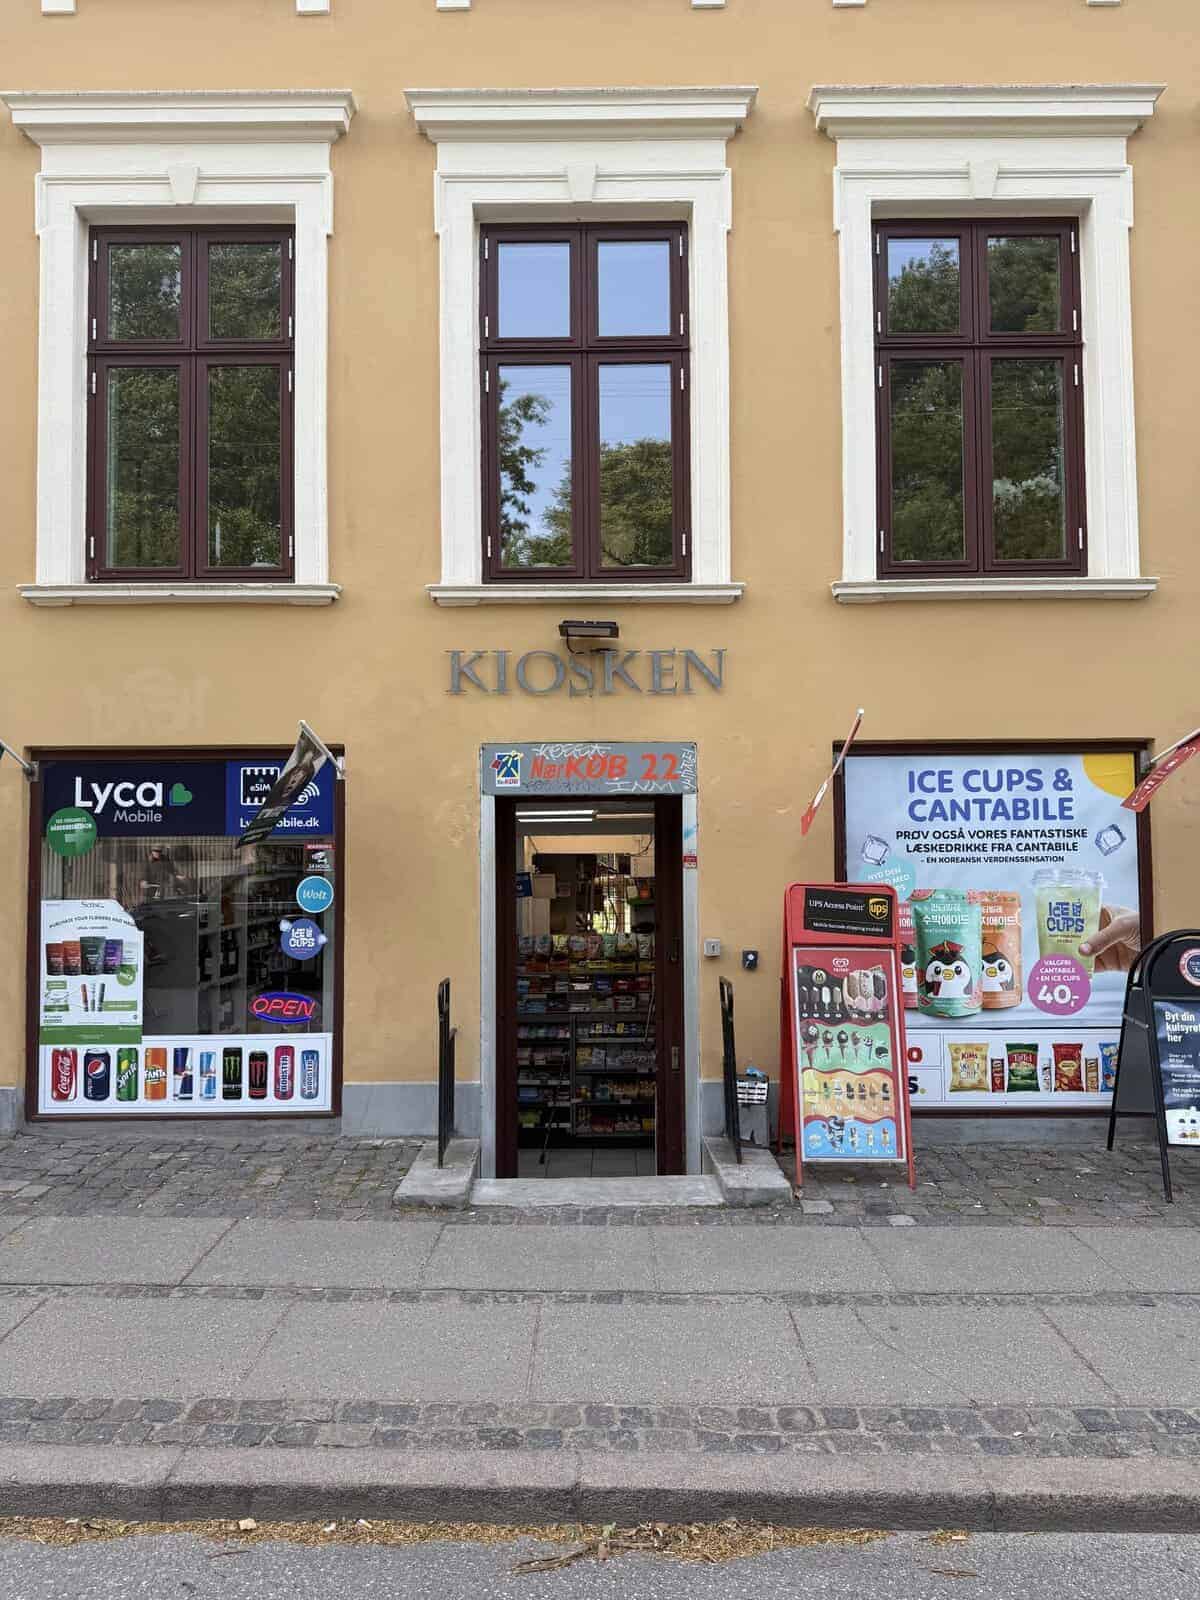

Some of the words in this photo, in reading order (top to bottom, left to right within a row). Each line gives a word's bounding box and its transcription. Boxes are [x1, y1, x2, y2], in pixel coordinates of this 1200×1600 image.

[445, 648, 728, 697] KIOSKEN
[639, 753, 681, 780] 22
[908, 770, 954, 793] ICE
[962, 768, 1044, 793] CUPS
[1052, 768, 1073, 791] &
[74, 776, 163, 814] Lyca
[908, 797, 1074, 822] CANTABILE
[113, 810, 162, 823] Mobile
[896, 830, 929, 840] PRØV
[932, 828, 964, 840] OGSÅ
[968, 830, 1007, 839] VORES
[1010, 828, 1088, 838] FANTASTISKE
[906, 843, 988, 853] LÆSKEDRIKKE
[991, 843, 1013, 853] FRA
[1016, 842, 1078, 852] CANTABILE
[938, 856, 981, 864] KOREANSK
[983, 855, 1065, 863] VERDENSSENSATION
[302, 889, 328, 900] Wolt
[870, 903, 888, 916] ups
[1048, 901, 1070, 916] ICE
[1046, 918, 1085, 933] CUPS
[288, 938, 315, 947] CUPS
[253, 998, 316, 1017] OPEN
[1165, 1011, 1179, 1022] Byt
[1181, 1011, 1195, 1021] din
[1167, 1034, 1182, 1042] her
